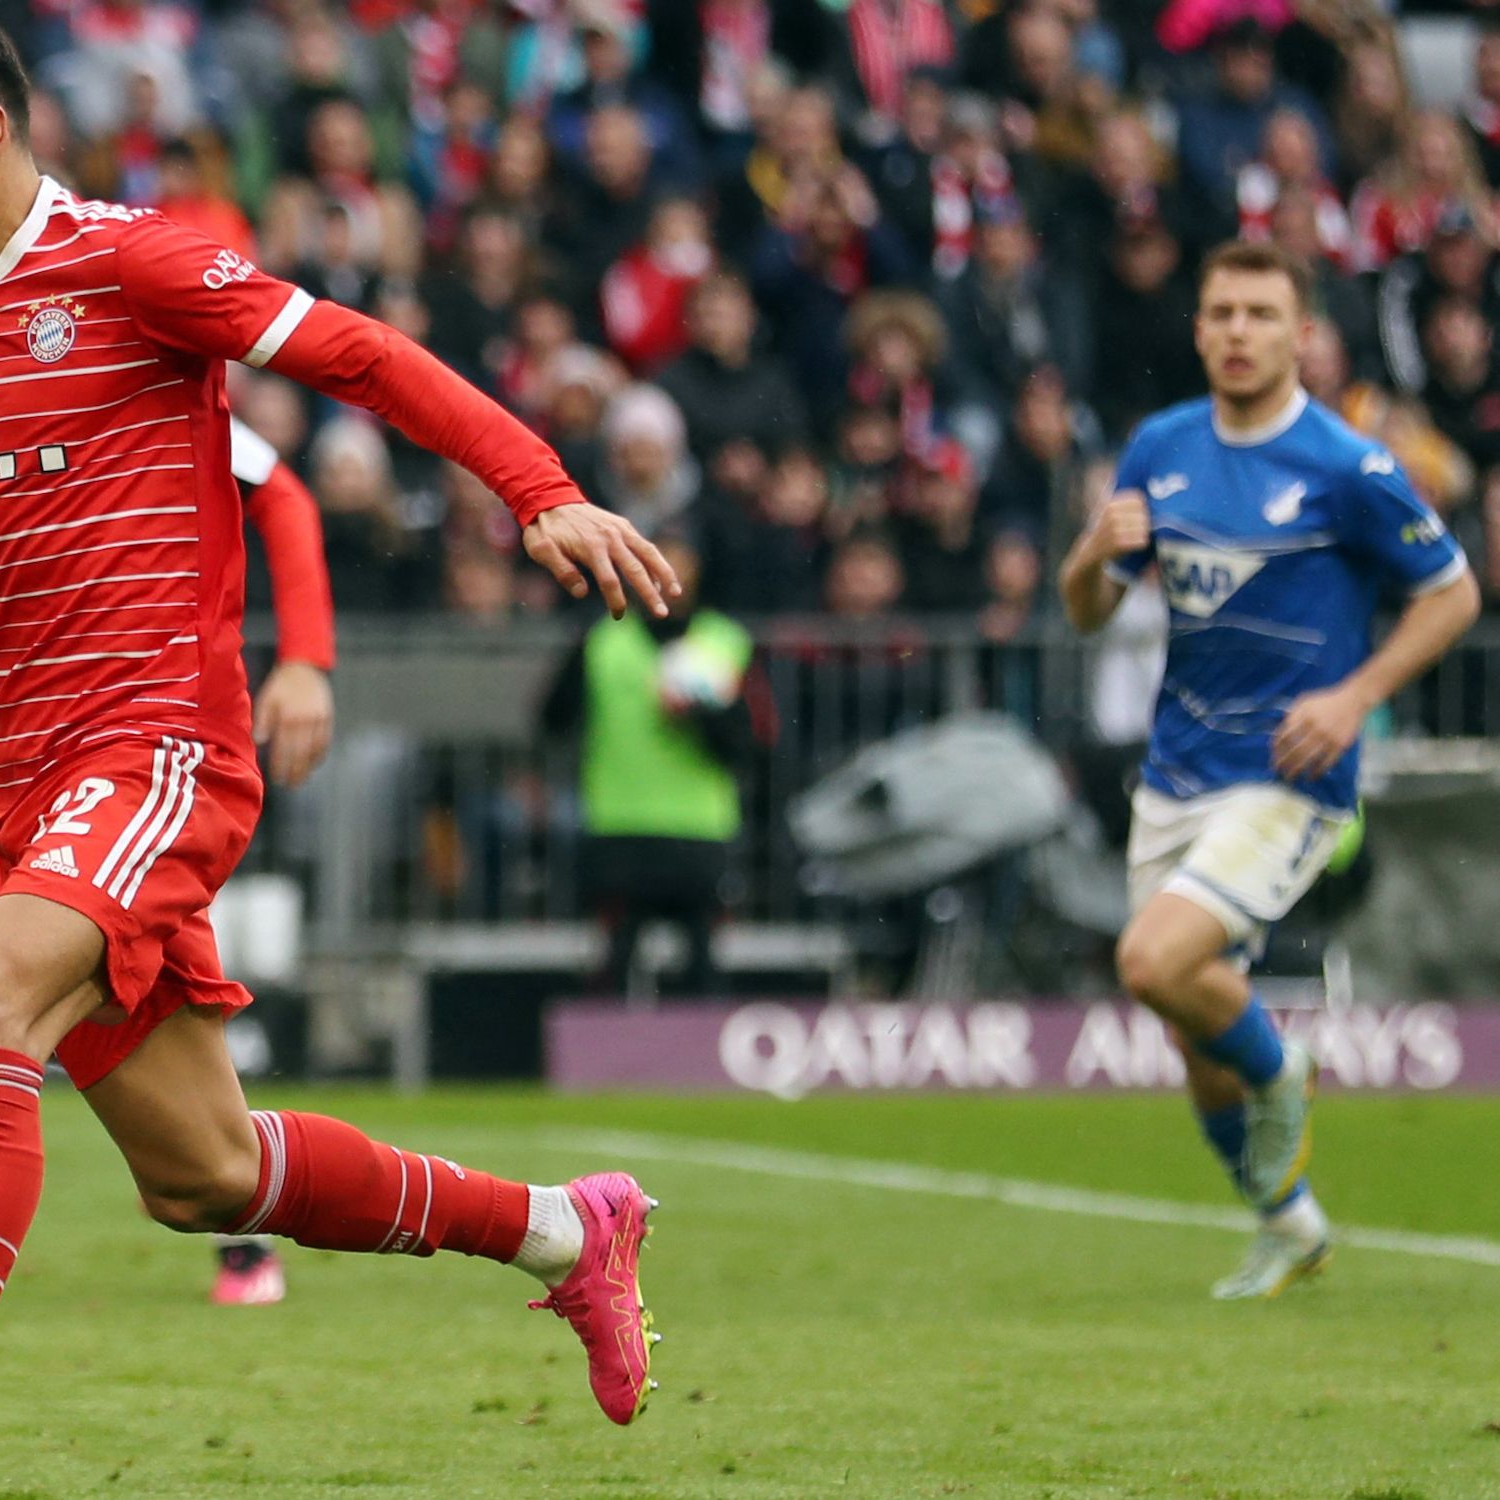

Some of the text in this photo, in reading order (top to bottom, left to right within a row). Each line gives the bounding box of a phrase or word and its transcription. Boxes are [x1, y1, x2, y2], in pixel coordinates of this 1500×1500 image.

[39, 312, 71, 330] BAYERN
[30, 859, 80, 878] adidas
[719, 1001, 1040, 1100] QATAR
